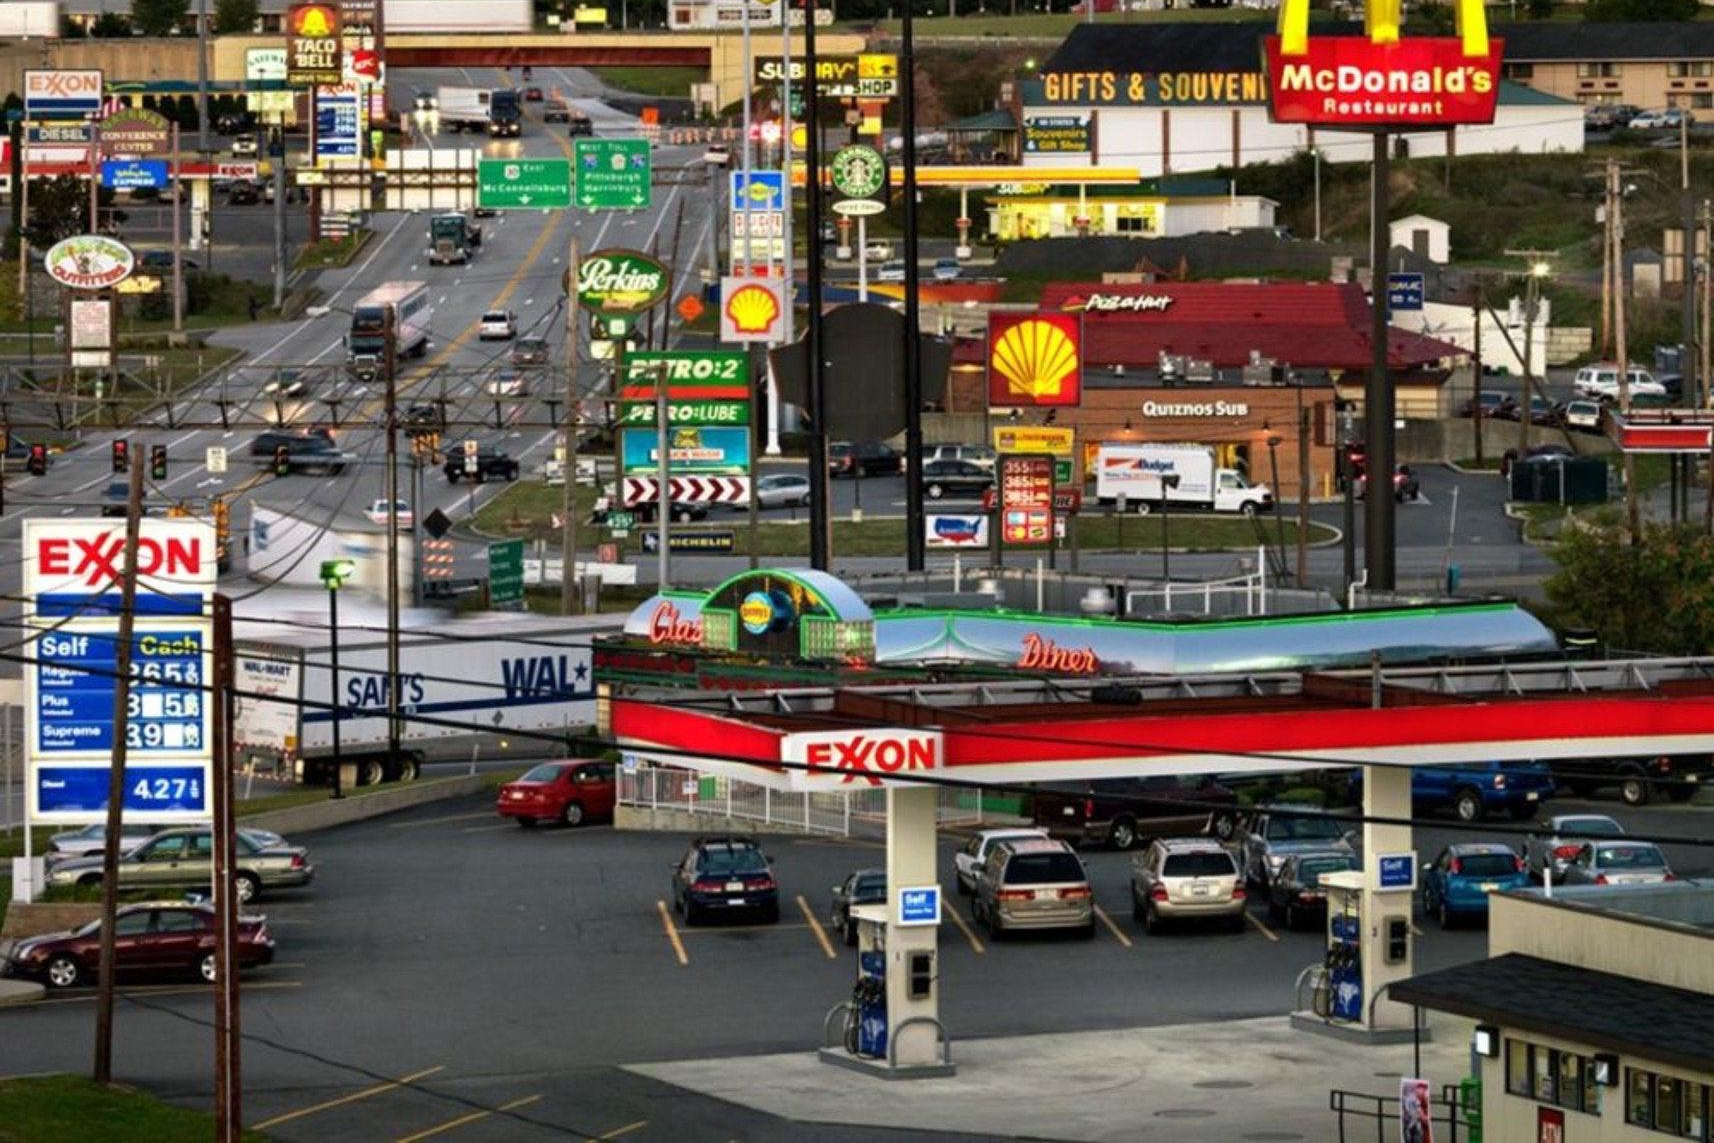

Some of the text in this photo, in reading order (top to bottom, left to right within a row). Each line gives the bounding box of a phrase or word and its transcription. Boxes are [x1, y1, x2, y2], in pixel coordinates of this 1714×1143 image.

[294, 38, 337, 53] TACO
[295, 53, 334, 68] BELL
[29, 74, 97, 97] EXXON
[1045, 72, 1268, 101] GIFTS & SOUVENI
[1280, 64, 1492, 93] McDonald's
[1323, 99, 1444, 116] Restaurant
[39, 128, 87, 140] DIESEL
[101, 132, 167, 140] CONFERENCE
[1027, 128, 1087, 139] Souvenirs
[221, 165, 254, 177] EXXON
[585, 173, 641, 183] Pittsburgh
[52, 263, 127, 286] OUTFITTERS
[577, 258, 660, 292] Perkins
[1086, 294, 1173, 311] Pizza Hut
[628, 359, 739, 379] PETRO:2
[629, 405, 739, 421] PERO:LUBE
[1138, 459, 1175, 472] Budget
[38, 531, 200, 588] EXXON
[650, 600, 703, 643] Clas
[41, 636, 199, 656] Self Cash
[1017, 632, 1099, 674] Diner
[243, 661, 291, 676] WAL-MART
[42, 695, 69, 707] Plus
[43, 725, 101, 739] Supreme
[806, 736, 937, 786] EXXON
